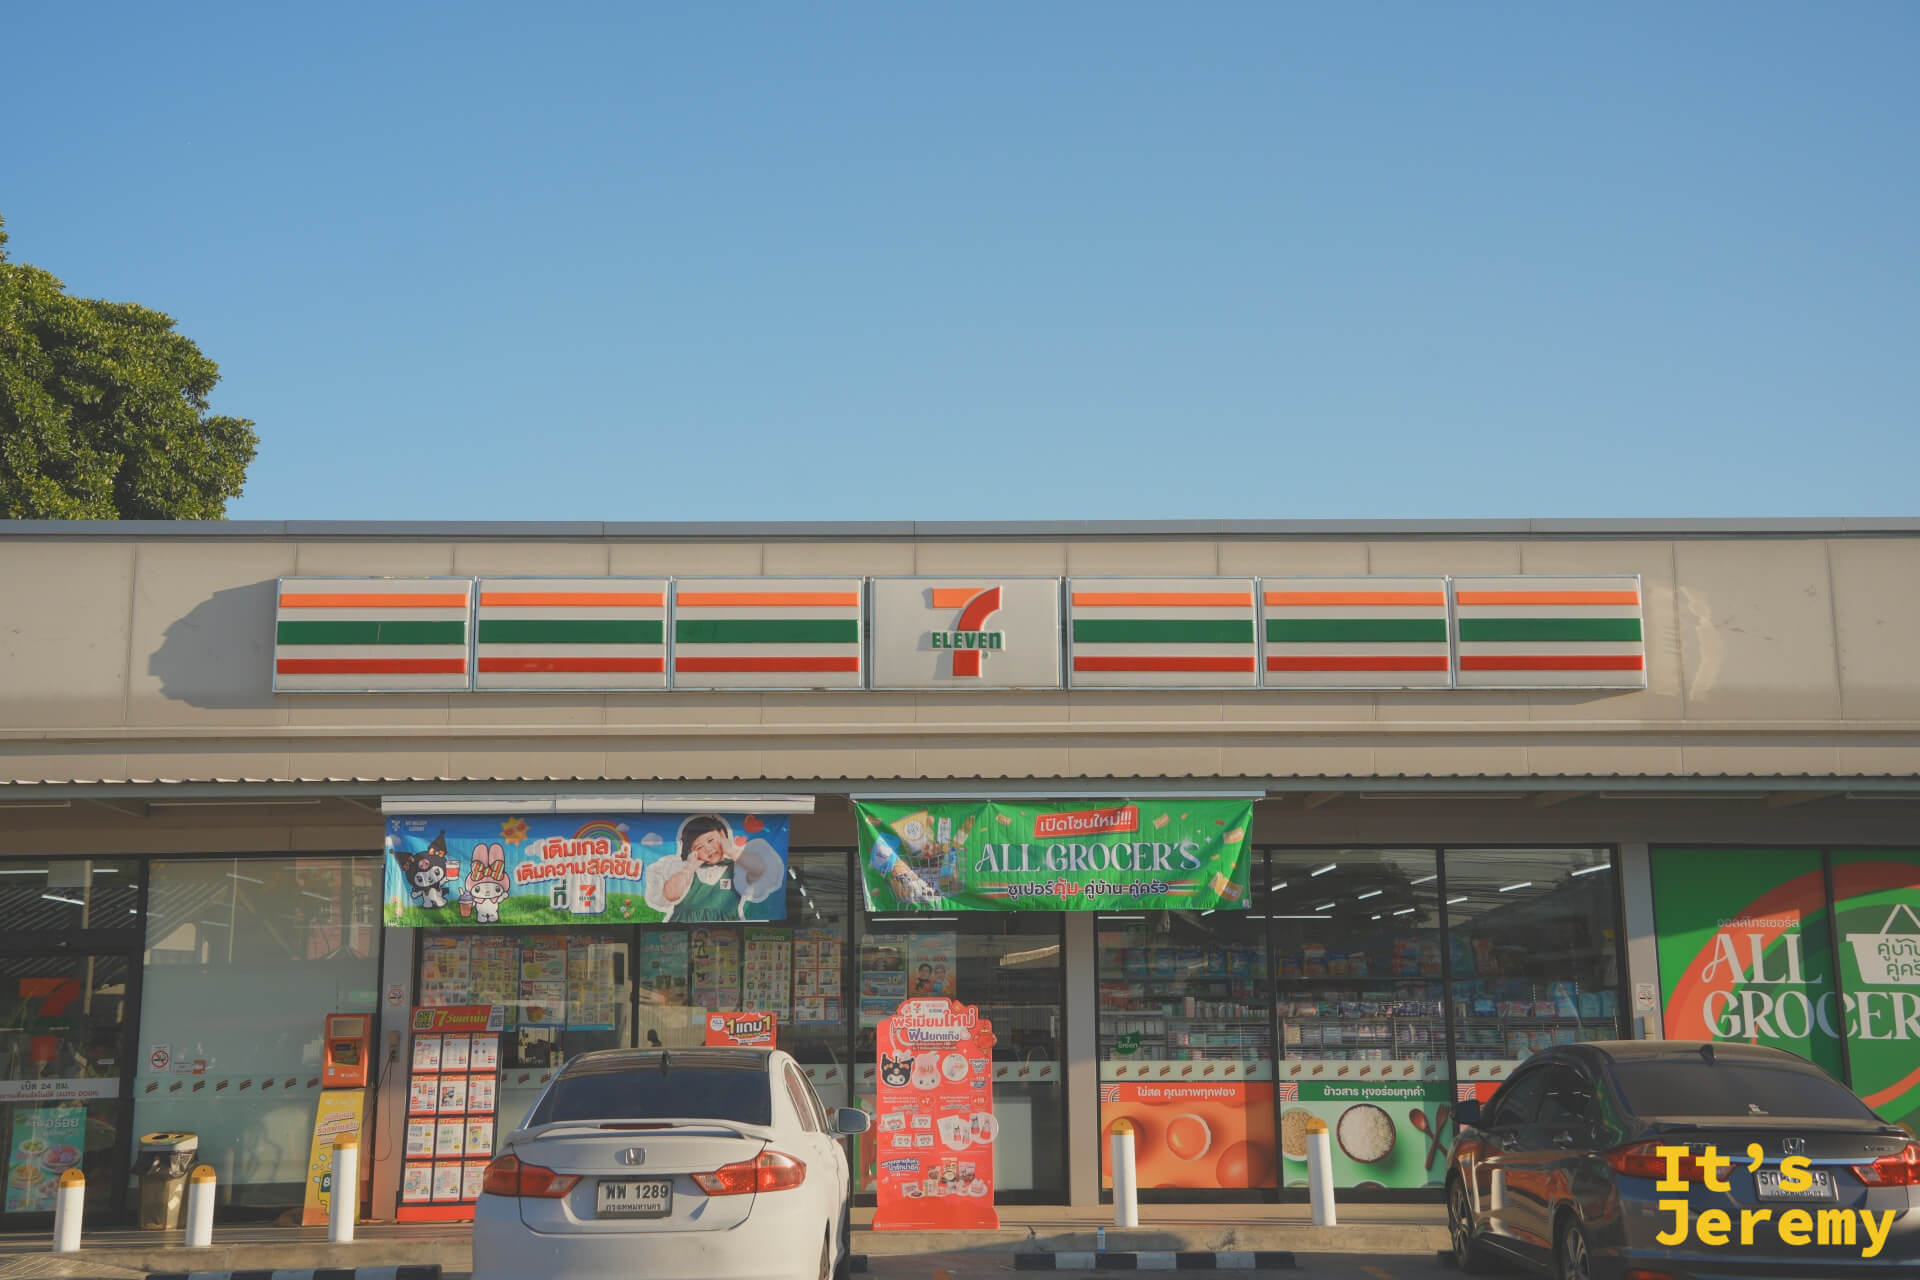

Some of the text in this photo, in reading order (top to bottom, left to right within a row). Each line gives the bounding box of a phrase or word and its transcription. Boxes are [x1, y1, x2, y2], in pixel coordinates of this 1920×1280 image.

[932, 585, 1001, 677] 7
[1040, 811, 1132, 833] เปิดโซนใหม่!!!
[516, 847, 640, 882] เติมความสดชื่น
[974, 840, 1201, 873] ALL GROCER'S
[553, 879, 568, 905] ที่
[1701, 933, 1822, 984] ALL
[1137, 1086, 1236, 1099] ไข่สด คุณภาพทุกฟอง
[1323, 1085, 1359, 1096] ข้าวสาร
[635, 1184, 669, 1199] 1289
